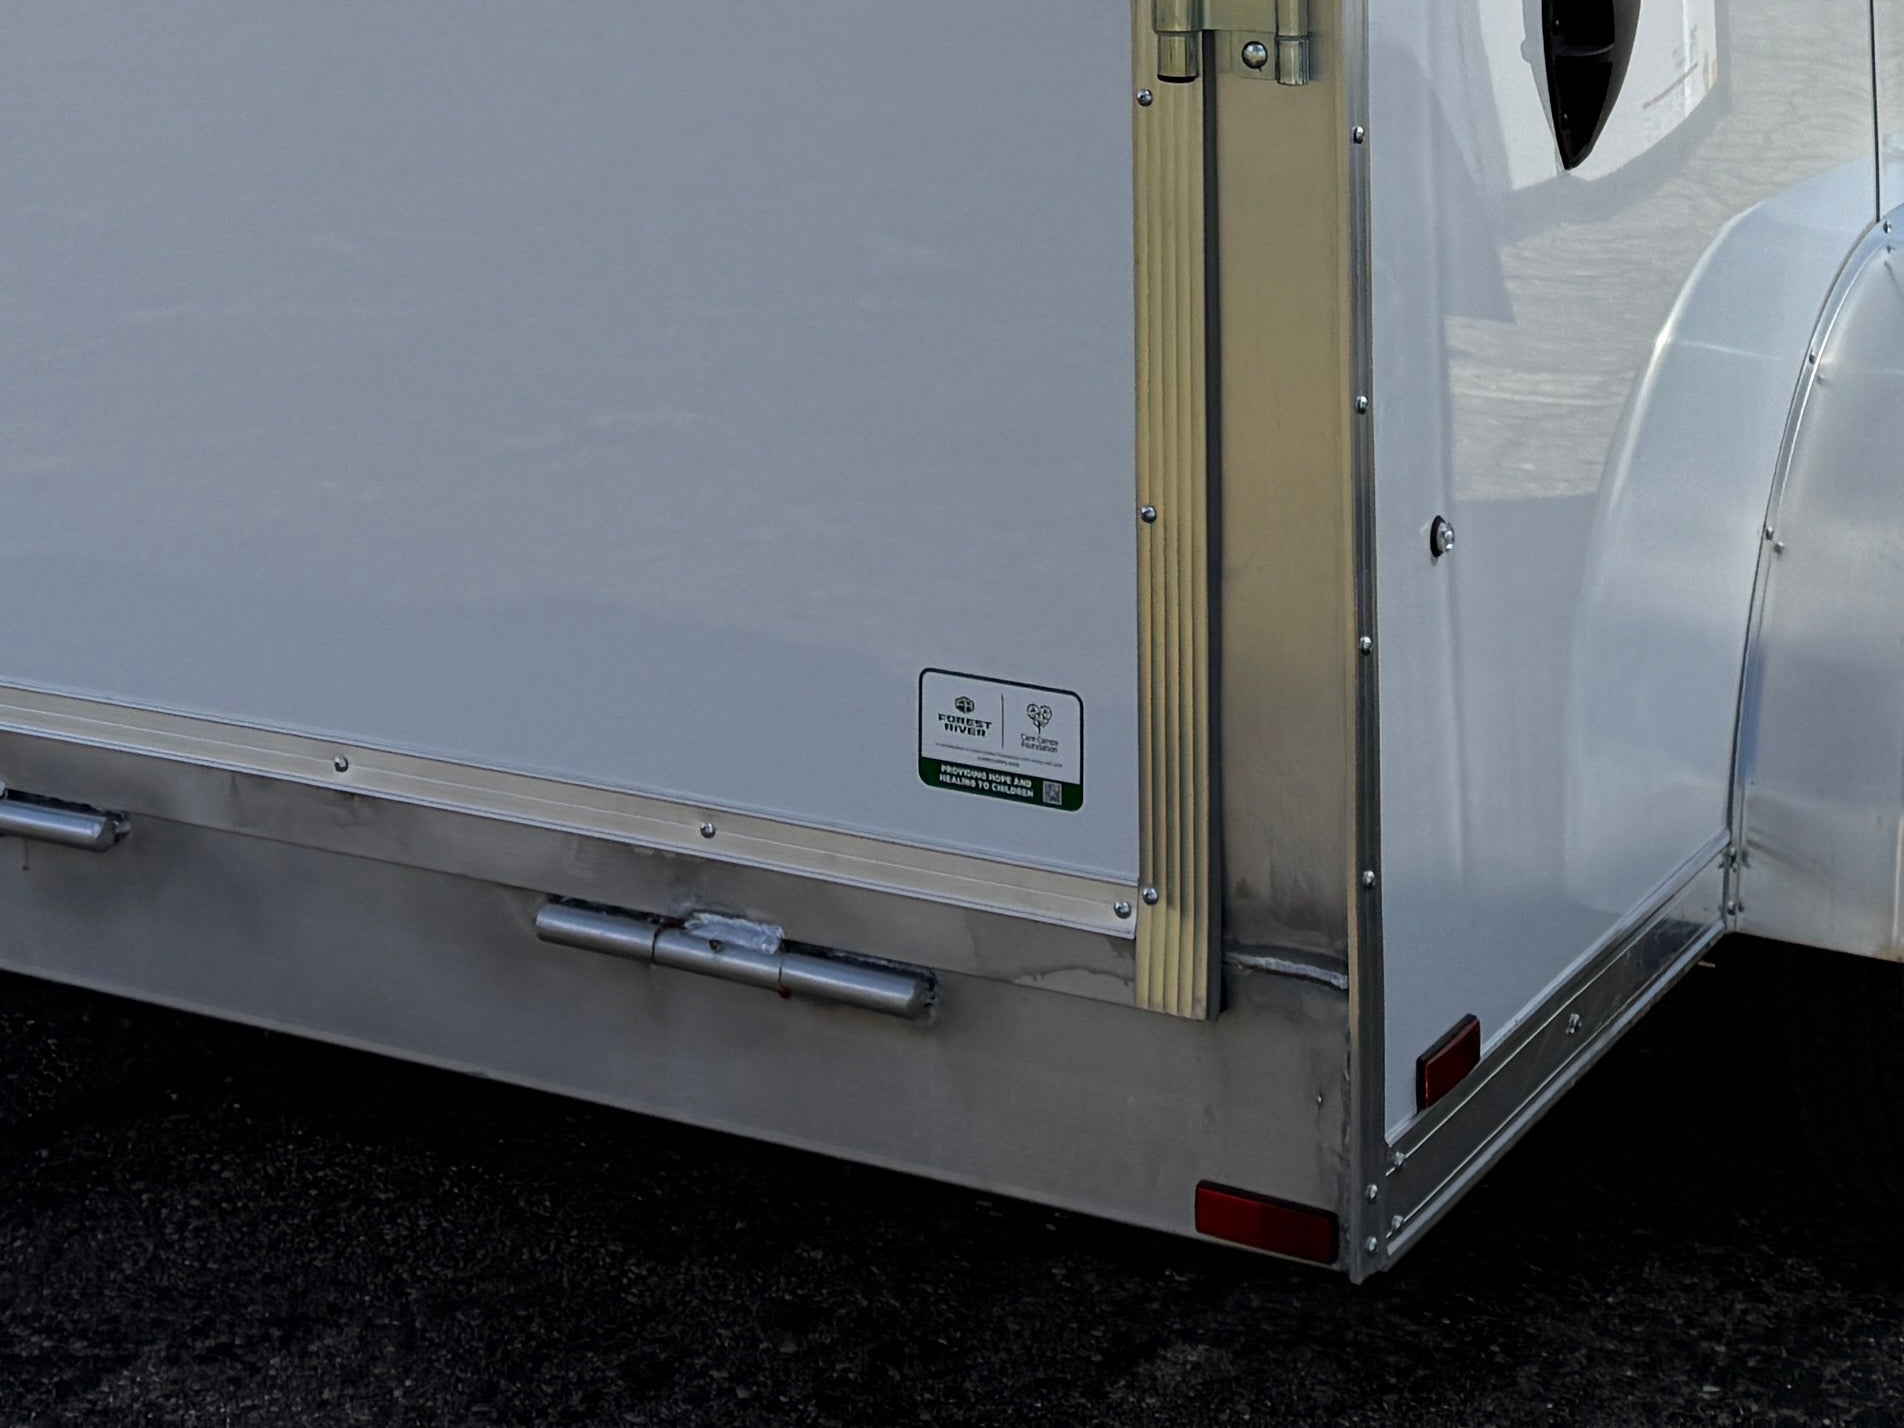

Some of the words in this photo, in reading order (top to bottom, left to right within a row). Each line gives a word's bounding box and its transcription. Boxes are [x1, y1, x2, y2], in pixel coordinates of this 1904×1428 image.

[937, 712, 993, 730] FOREST
[944, 722, 986, 737] RIVER
[978, 780, 990, 790] TO
[988, 771, 1012, 785] HOPE
[1014, 775, 1033, 789] AND
